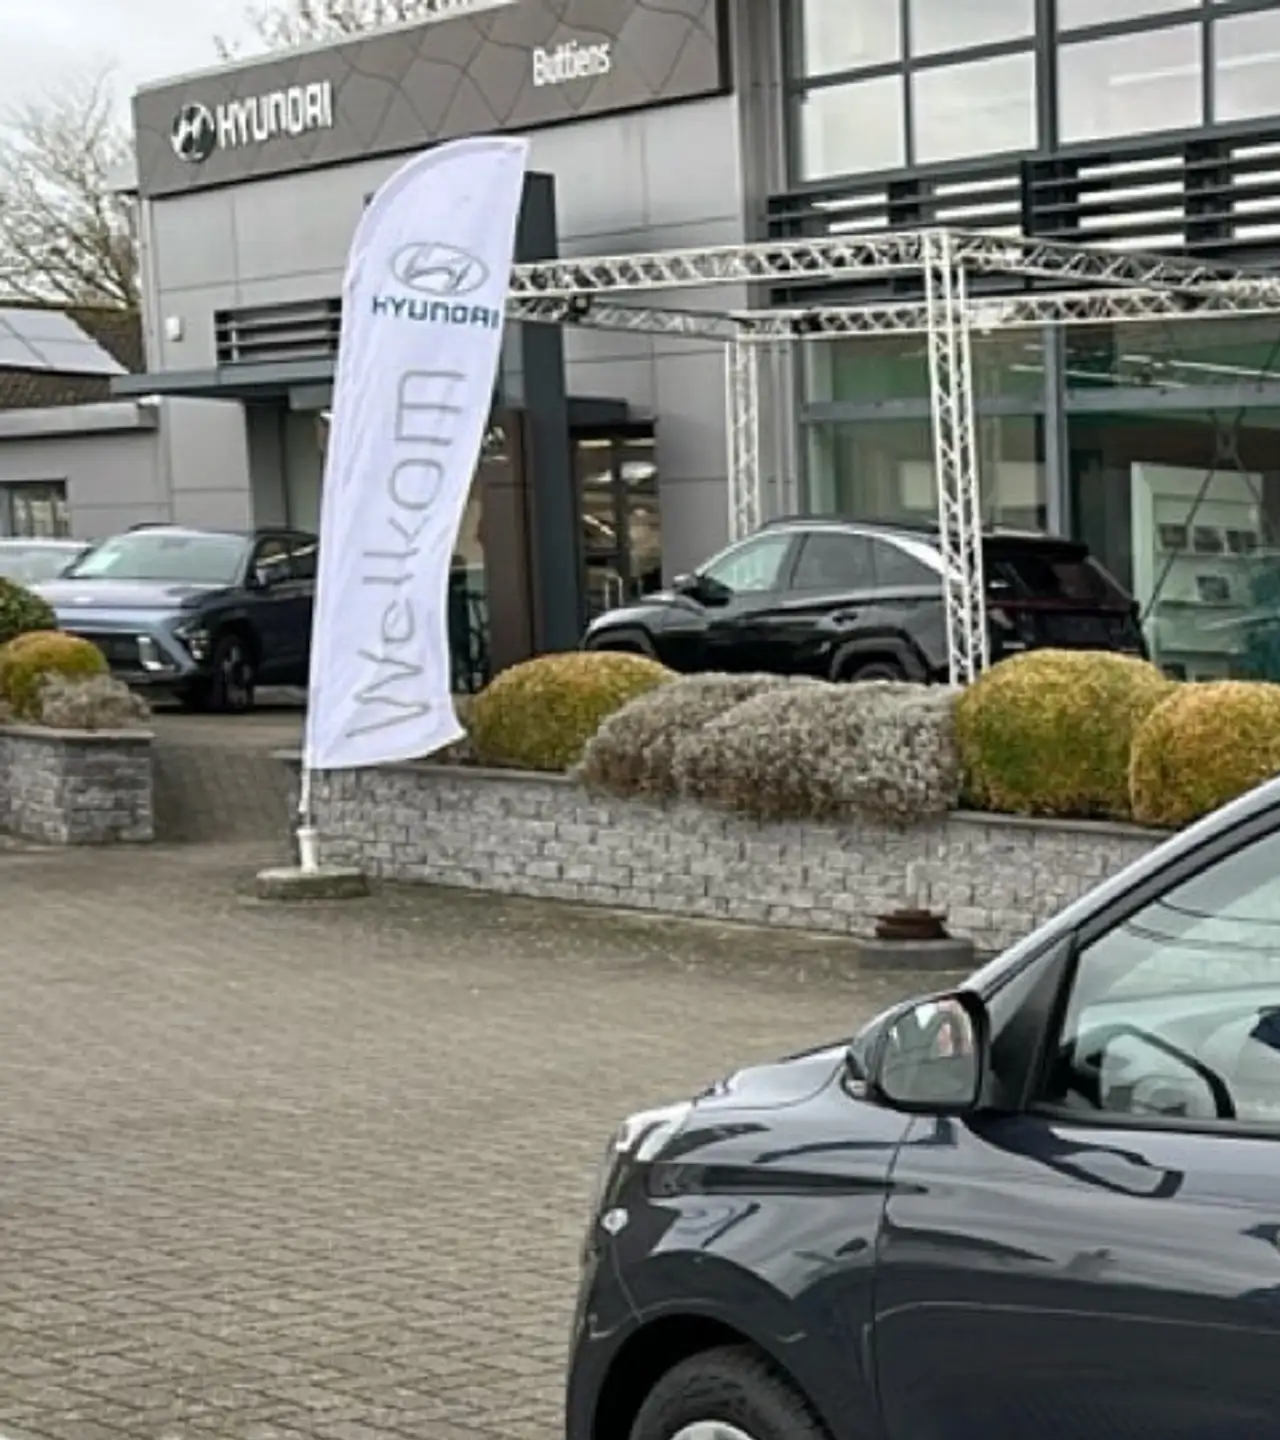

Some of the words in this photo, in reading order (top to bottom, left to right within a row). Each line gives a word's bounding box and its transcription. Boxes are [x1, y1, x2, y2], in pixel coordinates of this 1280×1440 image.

[215, 79, 333, 149] HYUNDAI
[372, 296, 499, 330] HYUNDAI
[344, 369, 468, 739] Welkom
